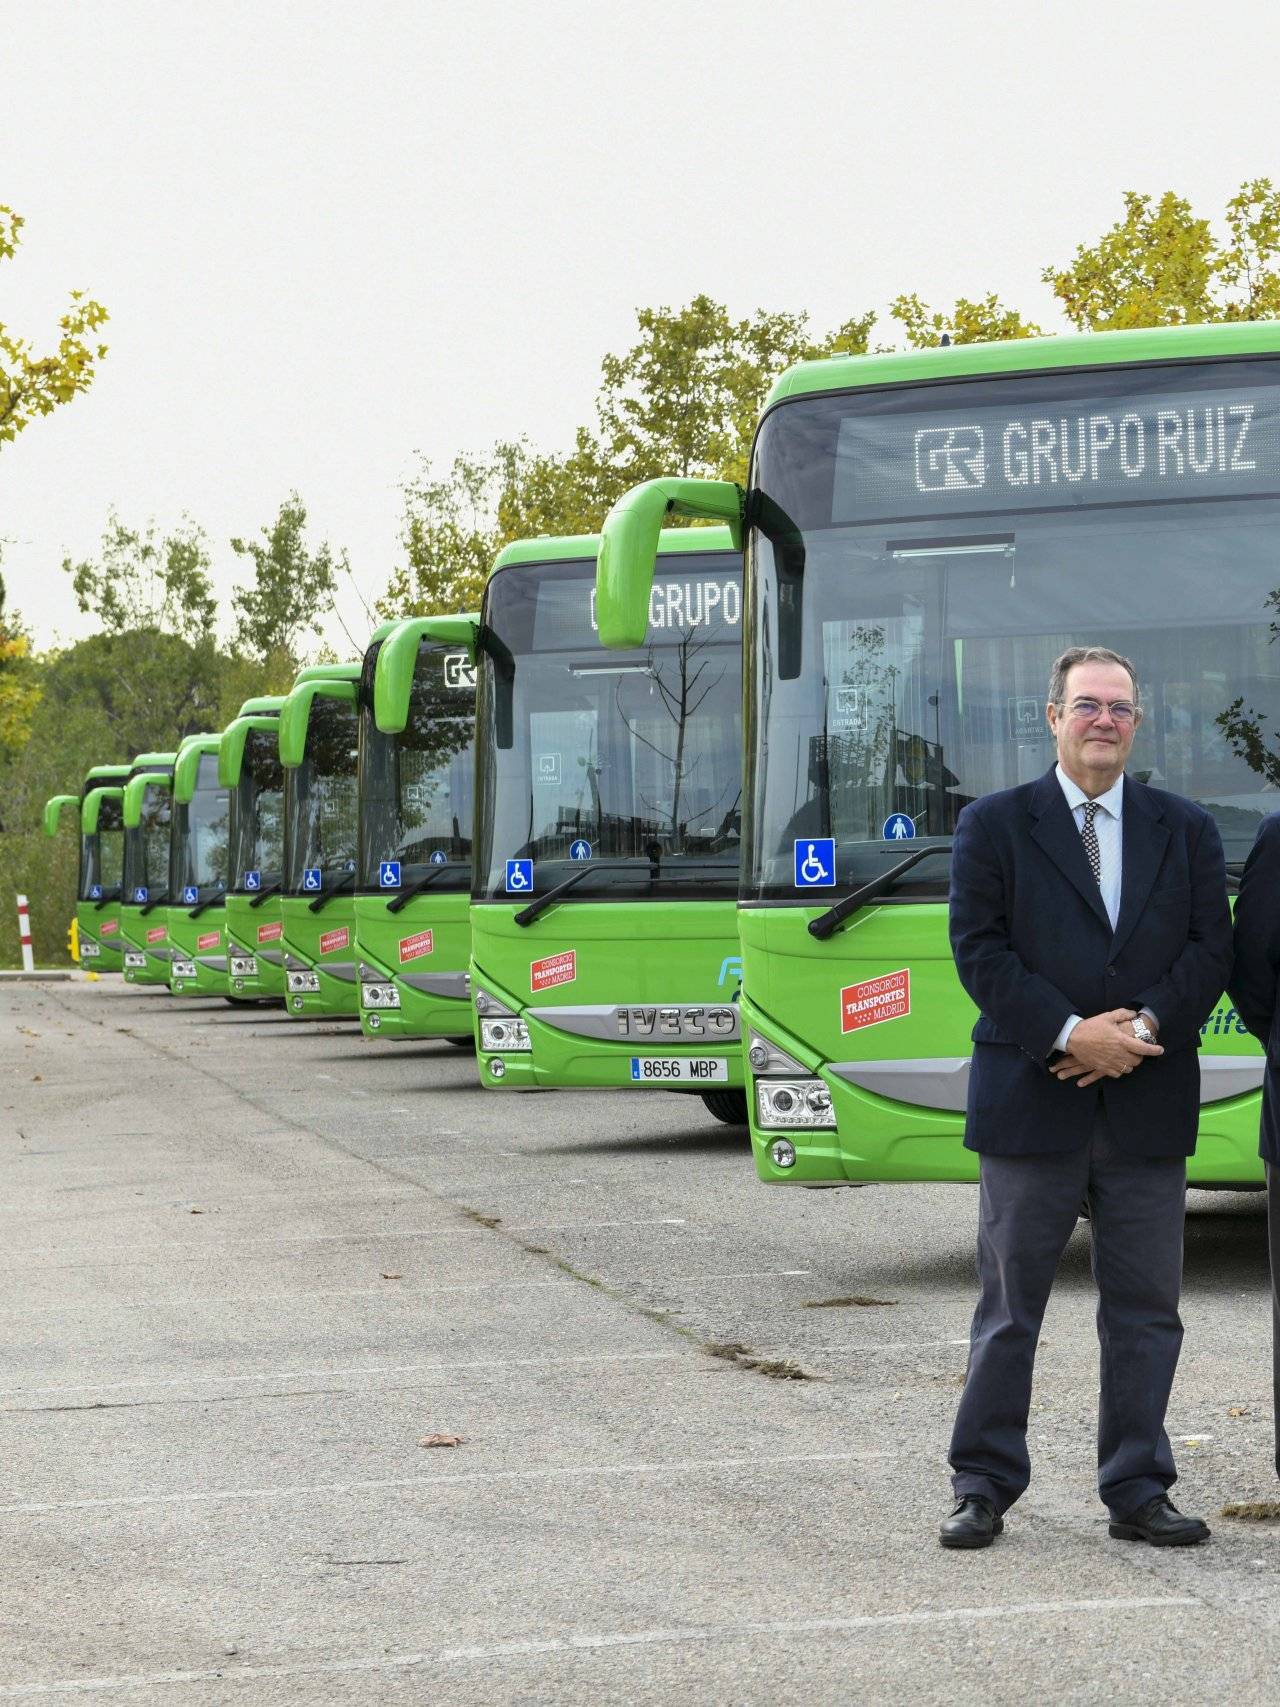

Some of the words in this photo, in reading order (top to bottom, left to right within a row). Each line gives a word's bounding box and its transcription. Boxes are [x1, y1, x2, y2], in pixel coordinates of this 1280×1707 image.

[1003, 414, 1144, 486] GRUPO
[1157, 405, 1256, 475] RUIZ
[648, 581, 740, 628] GRUPO
[857, 975, 905, 998] CONSORCIO
[846, 988, 905, 1015] TRANSPORTES
[873, 1001, 906, 1019] MADRID
[617, 1008, 736, 1035] IVECO
[643, 1060, 681, 1078] 8656
[689, 1060, 718, 1078] MBP
